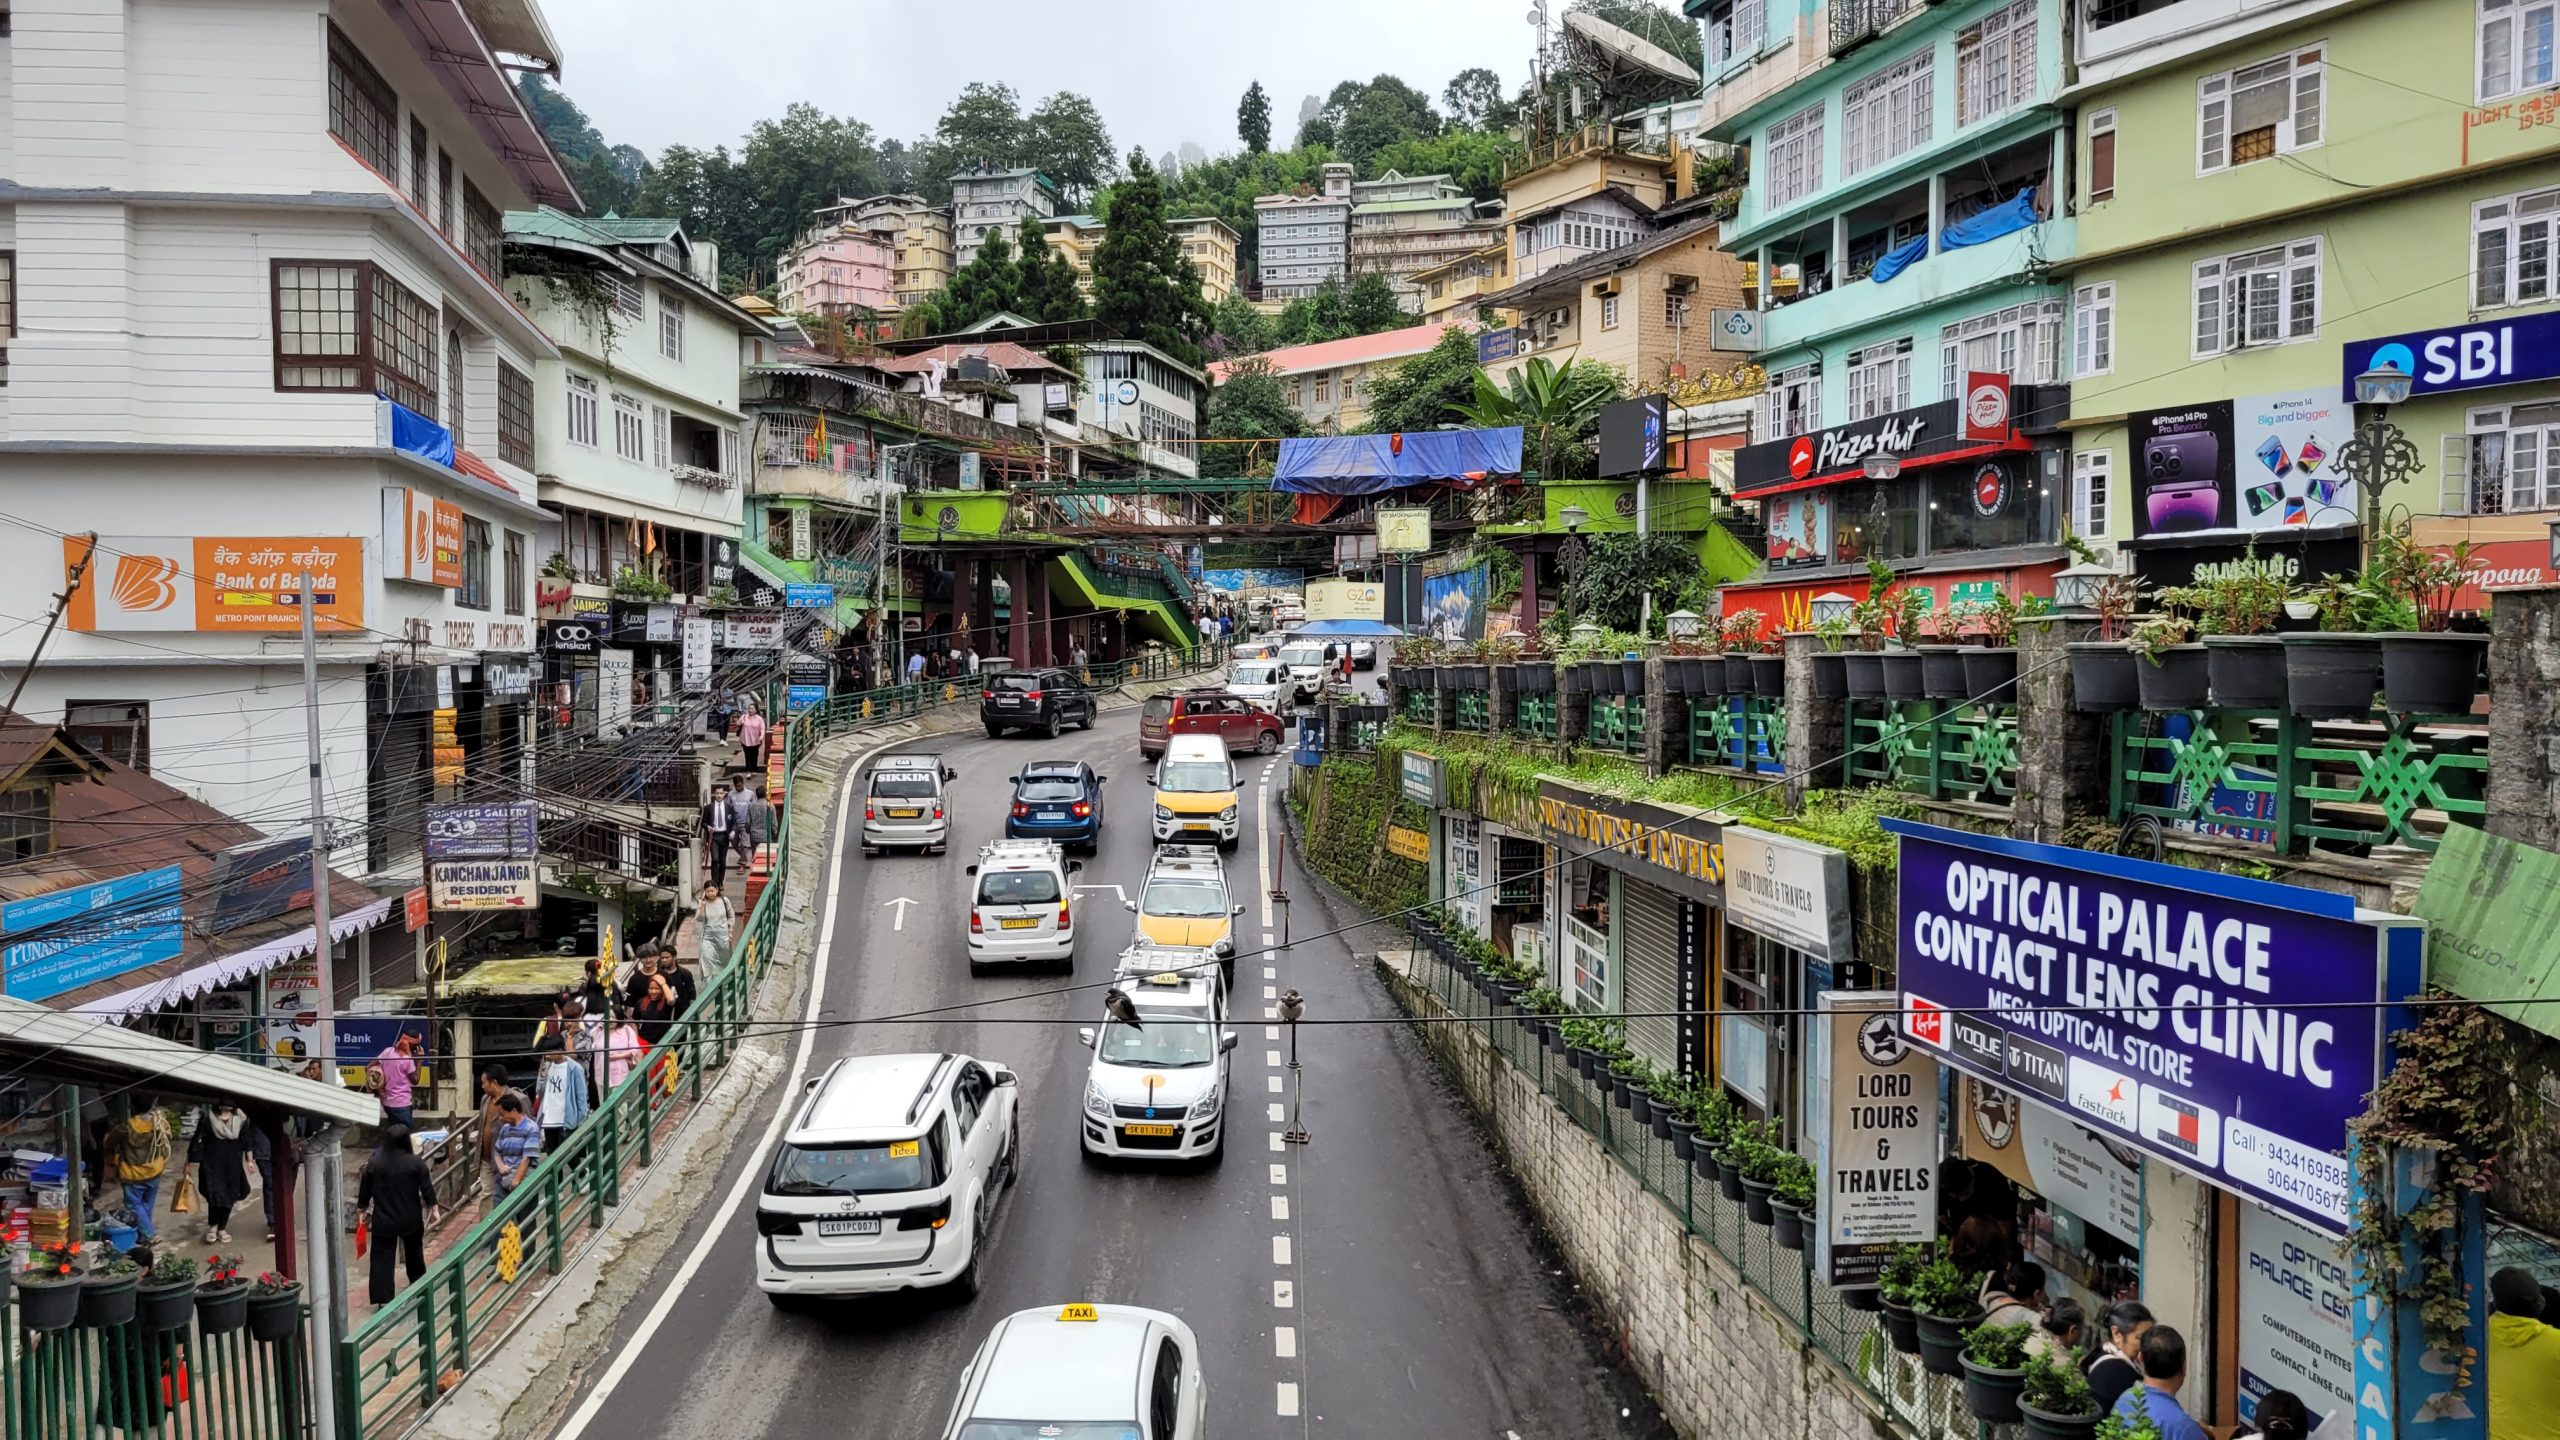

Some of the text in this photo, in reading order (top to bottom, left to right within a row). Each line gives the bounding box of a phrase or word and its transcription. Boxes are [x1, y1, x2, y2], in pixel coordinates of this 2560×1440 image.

[2470, 104, 2512, 127] LIGHT
[2520, 102, 2534, 114] OF
[2518, 109, 2555, 131] 1955
[2424, 326, 2513, 384] SBI
[1975, 403, 1998, 414] Pizza
[1979, 410, 1996, 420] Hut
[2279, 398, 2312, 409] iPhone 14
[2159, 411, 2208, 425] iPhone 14 Pro
[2257, 407, 2331, 425] Big and bigger.
[2158, 425, 2173, 434] Pro.
[1816, 415, 1926, 474] Pizza Hut
[214, 546, 242, 566] बैंक
[215, 572, 337, 590] Bank of Baoda
[215, 614, 242, 623] METRO
[243, 614, 265, 623] POINT
[267, 614, 300, 623] BRANCH
[749, 626, 773, 635] CARE
[555, 641, 592, 652] lenskart
[601, 659, 630, 673] RITZ
[877, 773, 930, 782] SIKKIM
[484, 808, 528, 818] GALLERY
[1538, 795, 1588, 839] SUNRISE
[1586, 809, 1631, 854] TOURS
[1645, 825, 1725, 886] TRAVELS
[434, 865, 531, 883] KANCHANJANGA
[450, 885, 518, 896] RESIDENCY
[1735, 867, 1813, 913] LORD TOURS & TRAVELS
[1946, 860, 2271, 994] OPTICAL PALACE
[10, 936, 62, 967] PUNAM
[273, 979, 316, 989] STIHL
[1914, 910, 2058, 998] CONTACT
[2066, 952, 2160, 1032] LENS
[2170, 982, 2334, 1089] CLINIC
[343, 1033, 372, 1044] Bank
[1987, 988, 2194, 1089] MEGA OPTICAL STORE
[2023, 1051, 2064, 1086] TITAN
[1858, 1073, 1911, 1099] LORD
[1850, 1105, 1919, 1130] TOURS
[2077, 1093, 2127, 1126] fastrack
[1876, 1137, 1890, 1161] &
[2232, 1129, 2256, 1154] Call
[2267, 1141, 2348, 1190] 9434169588
[2067, 1148, 2082, 1163] Ticket
[2082, 1156, 2103, 1175] Booking
[1837, 1168, 1930, 1194] TRAVELS
[2266, 1168, 2348, 1216] 9064705675
[825, 1222, 878, 1232] SK01PC0071
[2250, 1251, 2314, 1301] PALACE
[2282, 1241, 2350, 1292] OPTICAL
[1068, 1308, 1093, 1318] TAXI
[2262, 1313, 2322, 1355] COMPUTERISED
[2270, 1347, 2307, 1377] CONTACT
[2308, 1369, 2333, 1393] LENSE
[2312, 1357, 2319, 1369] &
